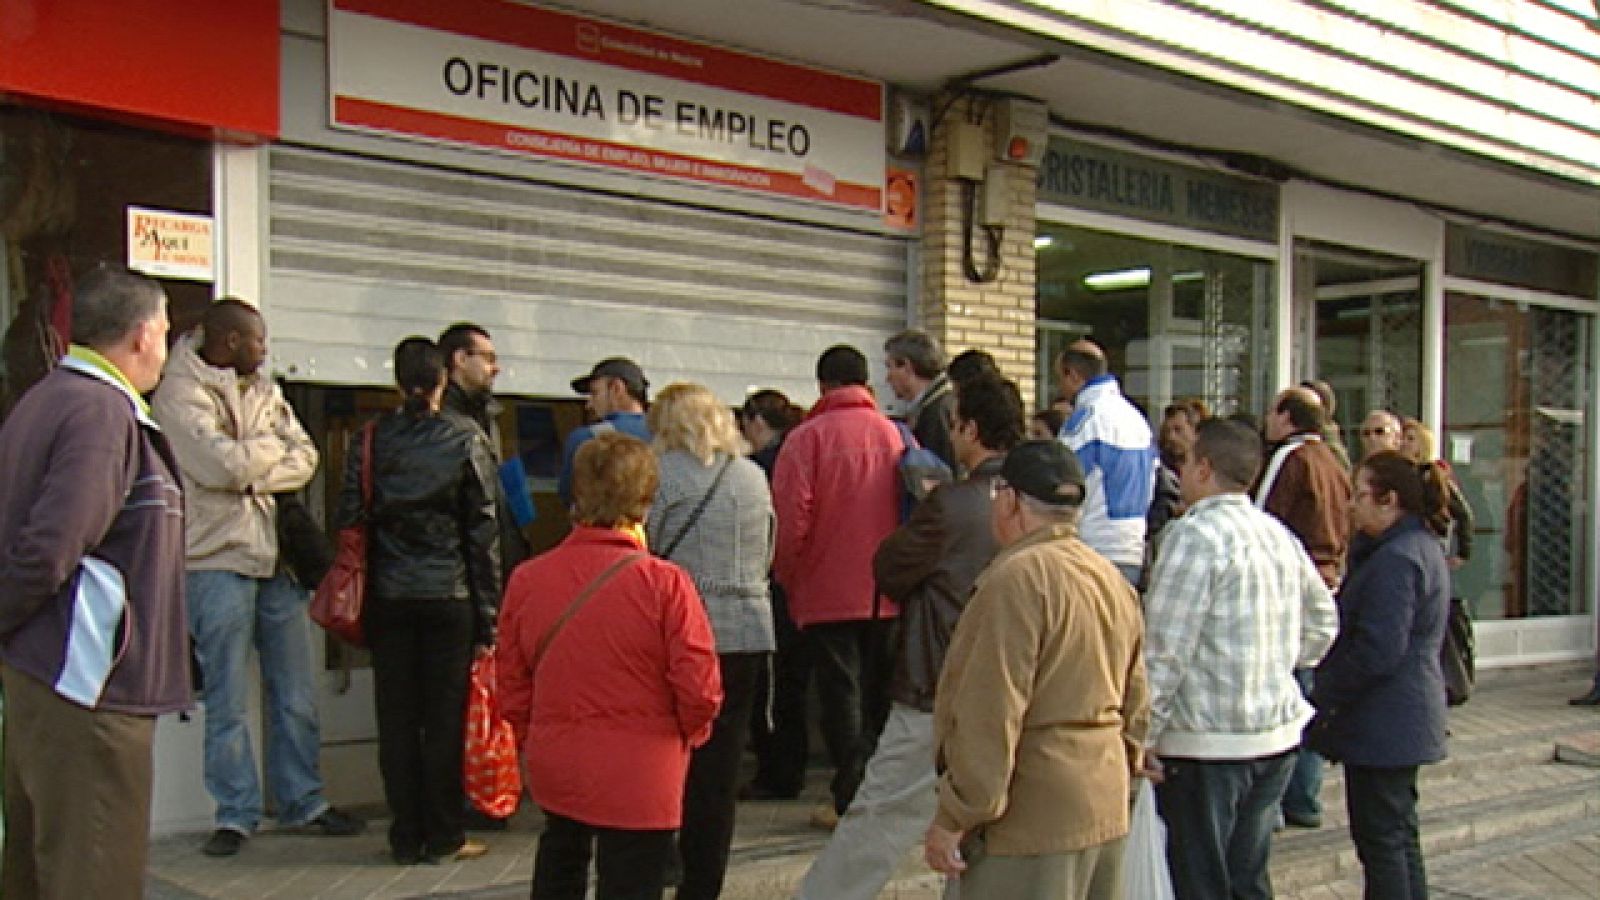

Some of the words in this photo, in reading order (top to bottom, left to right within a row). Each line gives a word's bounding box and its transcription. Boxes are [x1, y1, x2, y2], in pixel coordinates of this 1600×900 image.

[444, 57, 605, 120] OFICINA
[617, 89, 664, 131] DE
[676, 101, 810, 158] EMPLEO
